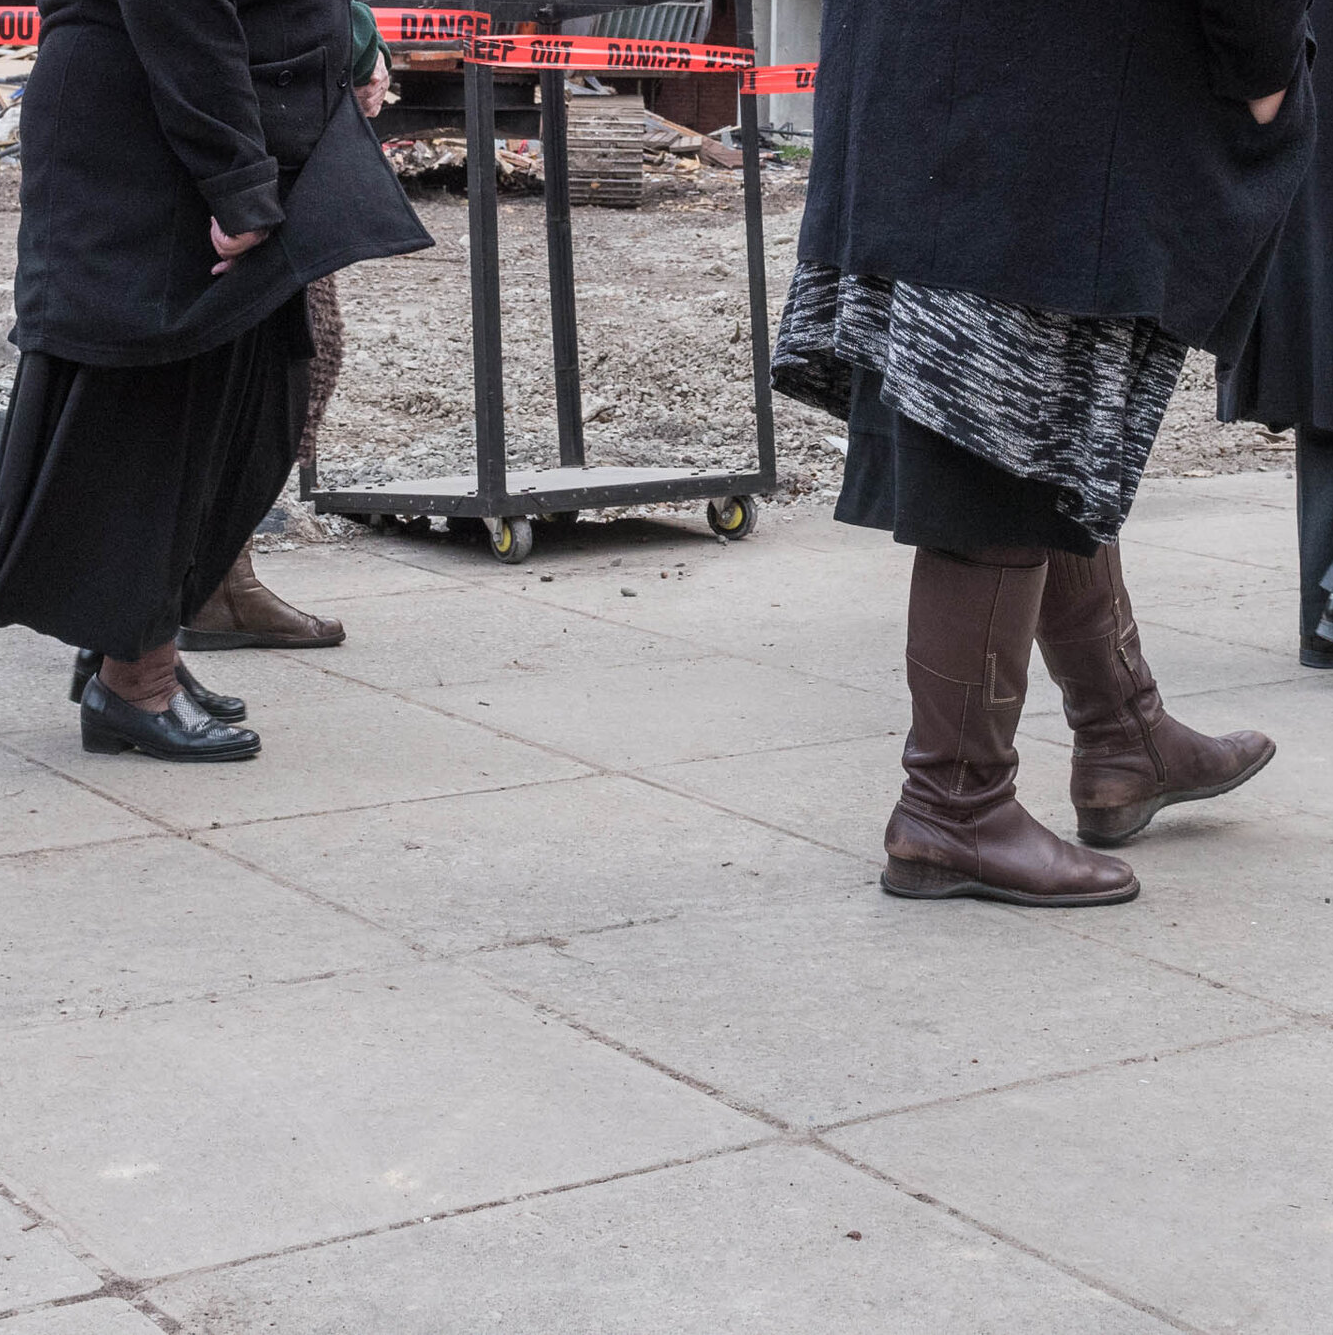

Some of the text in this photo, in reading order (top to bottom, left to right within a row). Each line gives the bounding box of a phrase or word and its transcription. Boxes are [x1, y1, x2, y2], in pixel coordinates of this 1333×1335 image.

[401, 13, 491, 42] DANGE
[530, 39, 574, 66] OUT
[607, 42, 691, 70] DANGER
